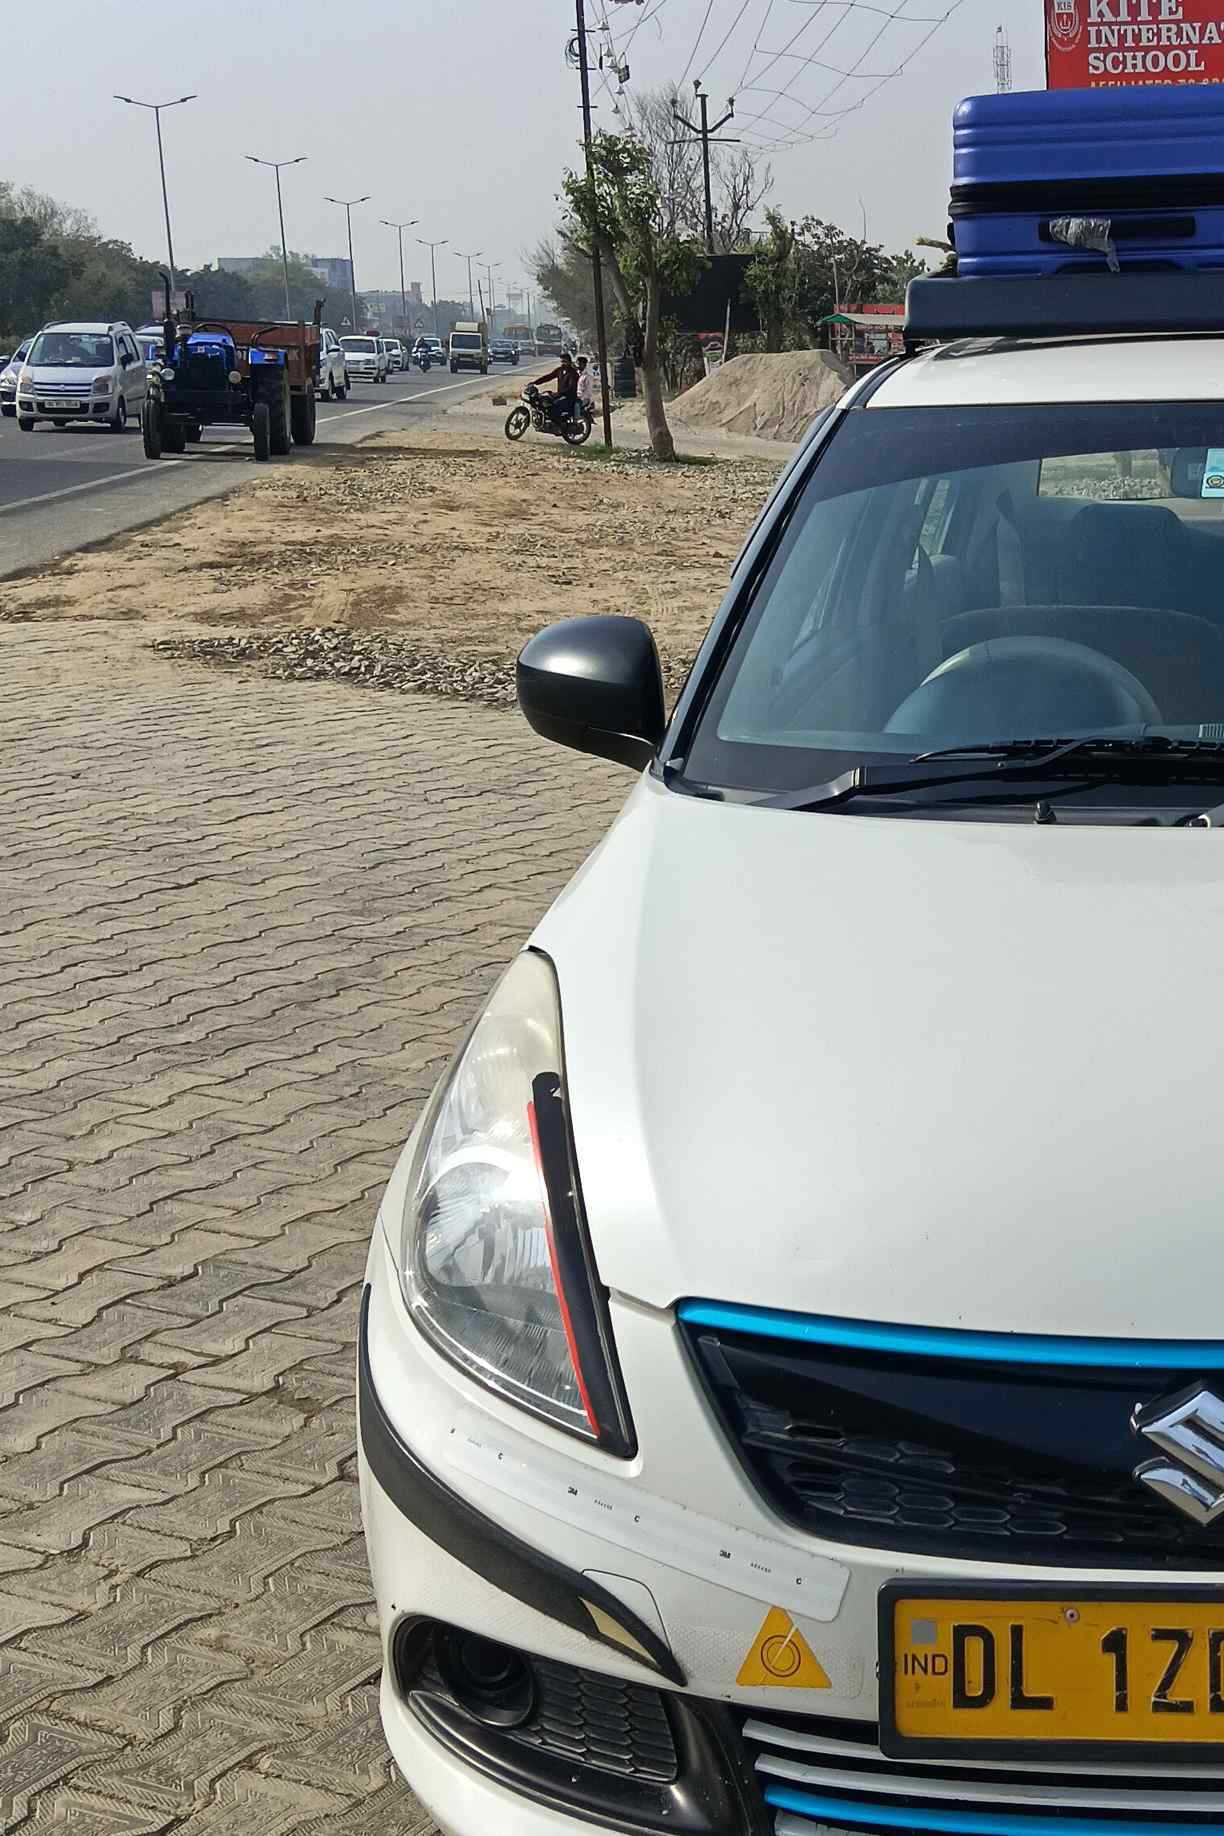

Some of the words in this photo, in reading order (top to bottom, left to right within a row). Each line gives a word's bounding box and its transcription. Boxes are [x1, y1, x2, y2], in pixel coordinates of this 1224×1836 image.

[1088, 0, 1183, 22] KITE
[1088, 49, 1205, 74] SCHOOL
[903, 1652, 949, 1676] IND
[952, 1623, 1055, 1710] DL
